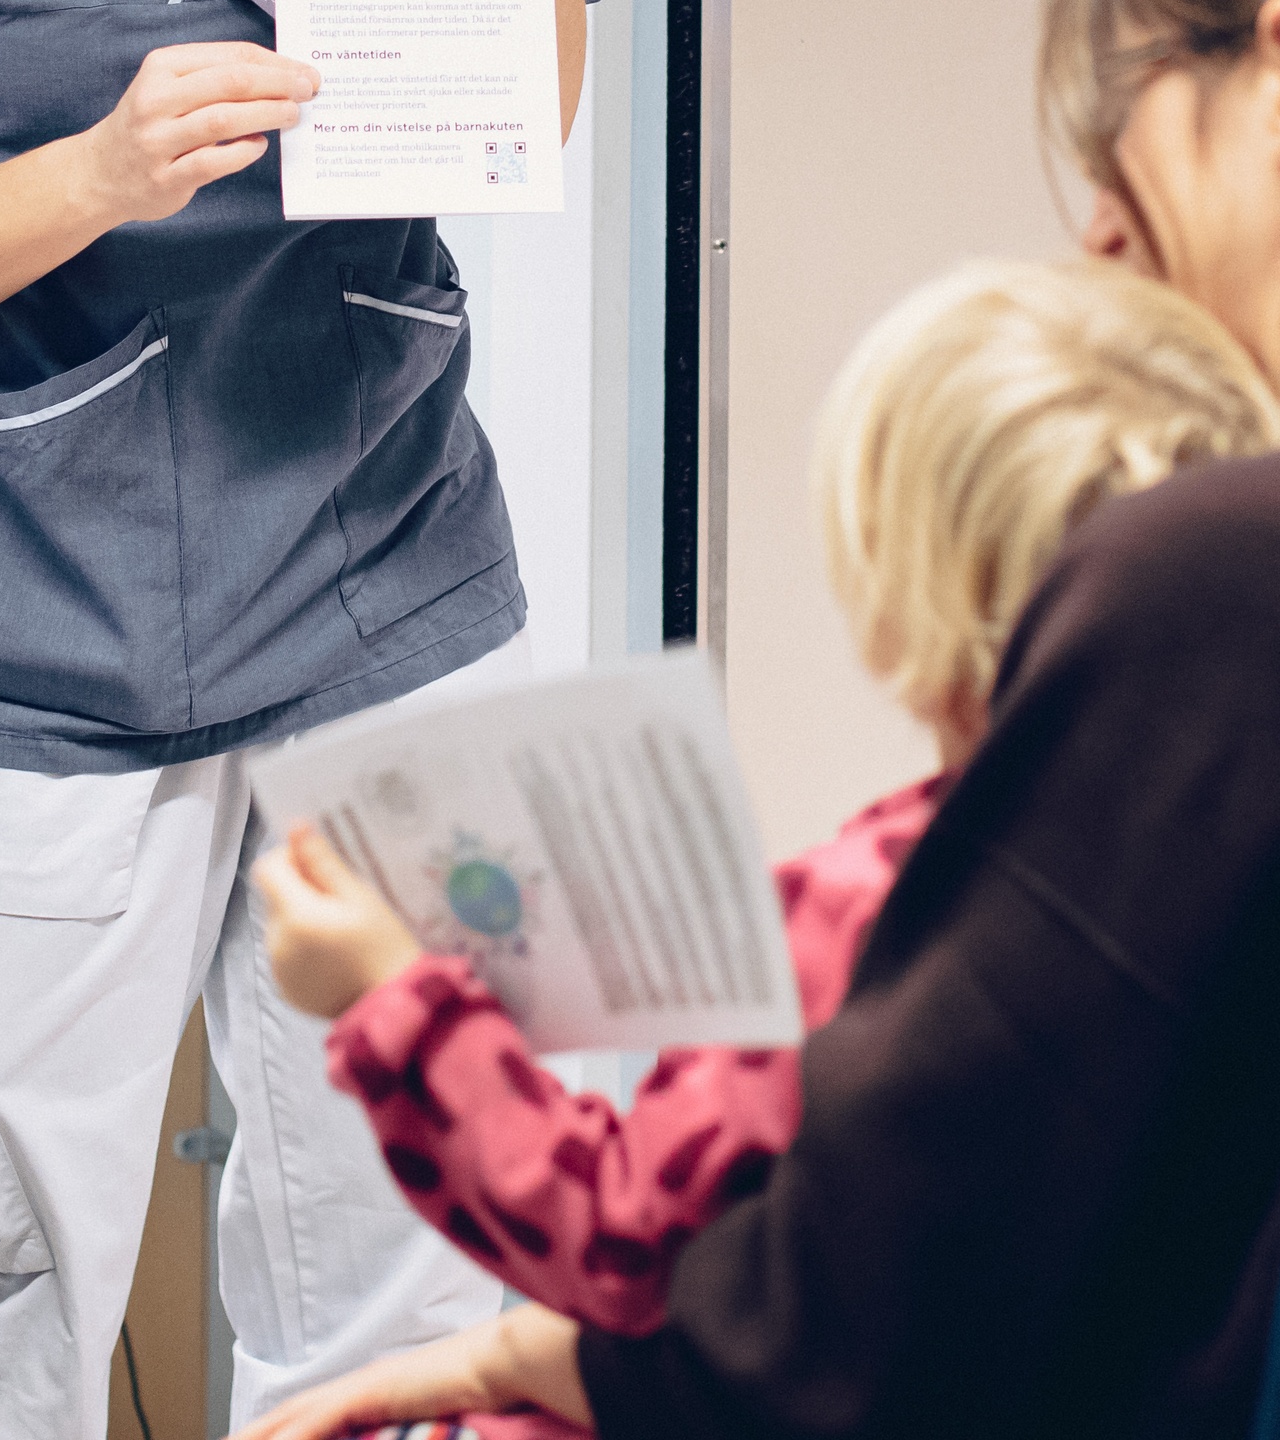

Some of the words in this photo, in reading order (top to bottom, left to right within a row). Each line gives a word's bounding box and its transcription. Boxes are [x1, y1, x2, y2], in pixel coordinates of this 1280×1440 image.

[312, 49, 332, 59] Om
[337, 50, 401, 59] väntetiden
[314, 123, 335, 132] Mer
[364, 123, 382, 132] din
[387, 123, 431, 132] vistelse
[436, 122, 451, 134] på
[455, 121, 524, 131] barnakuten
